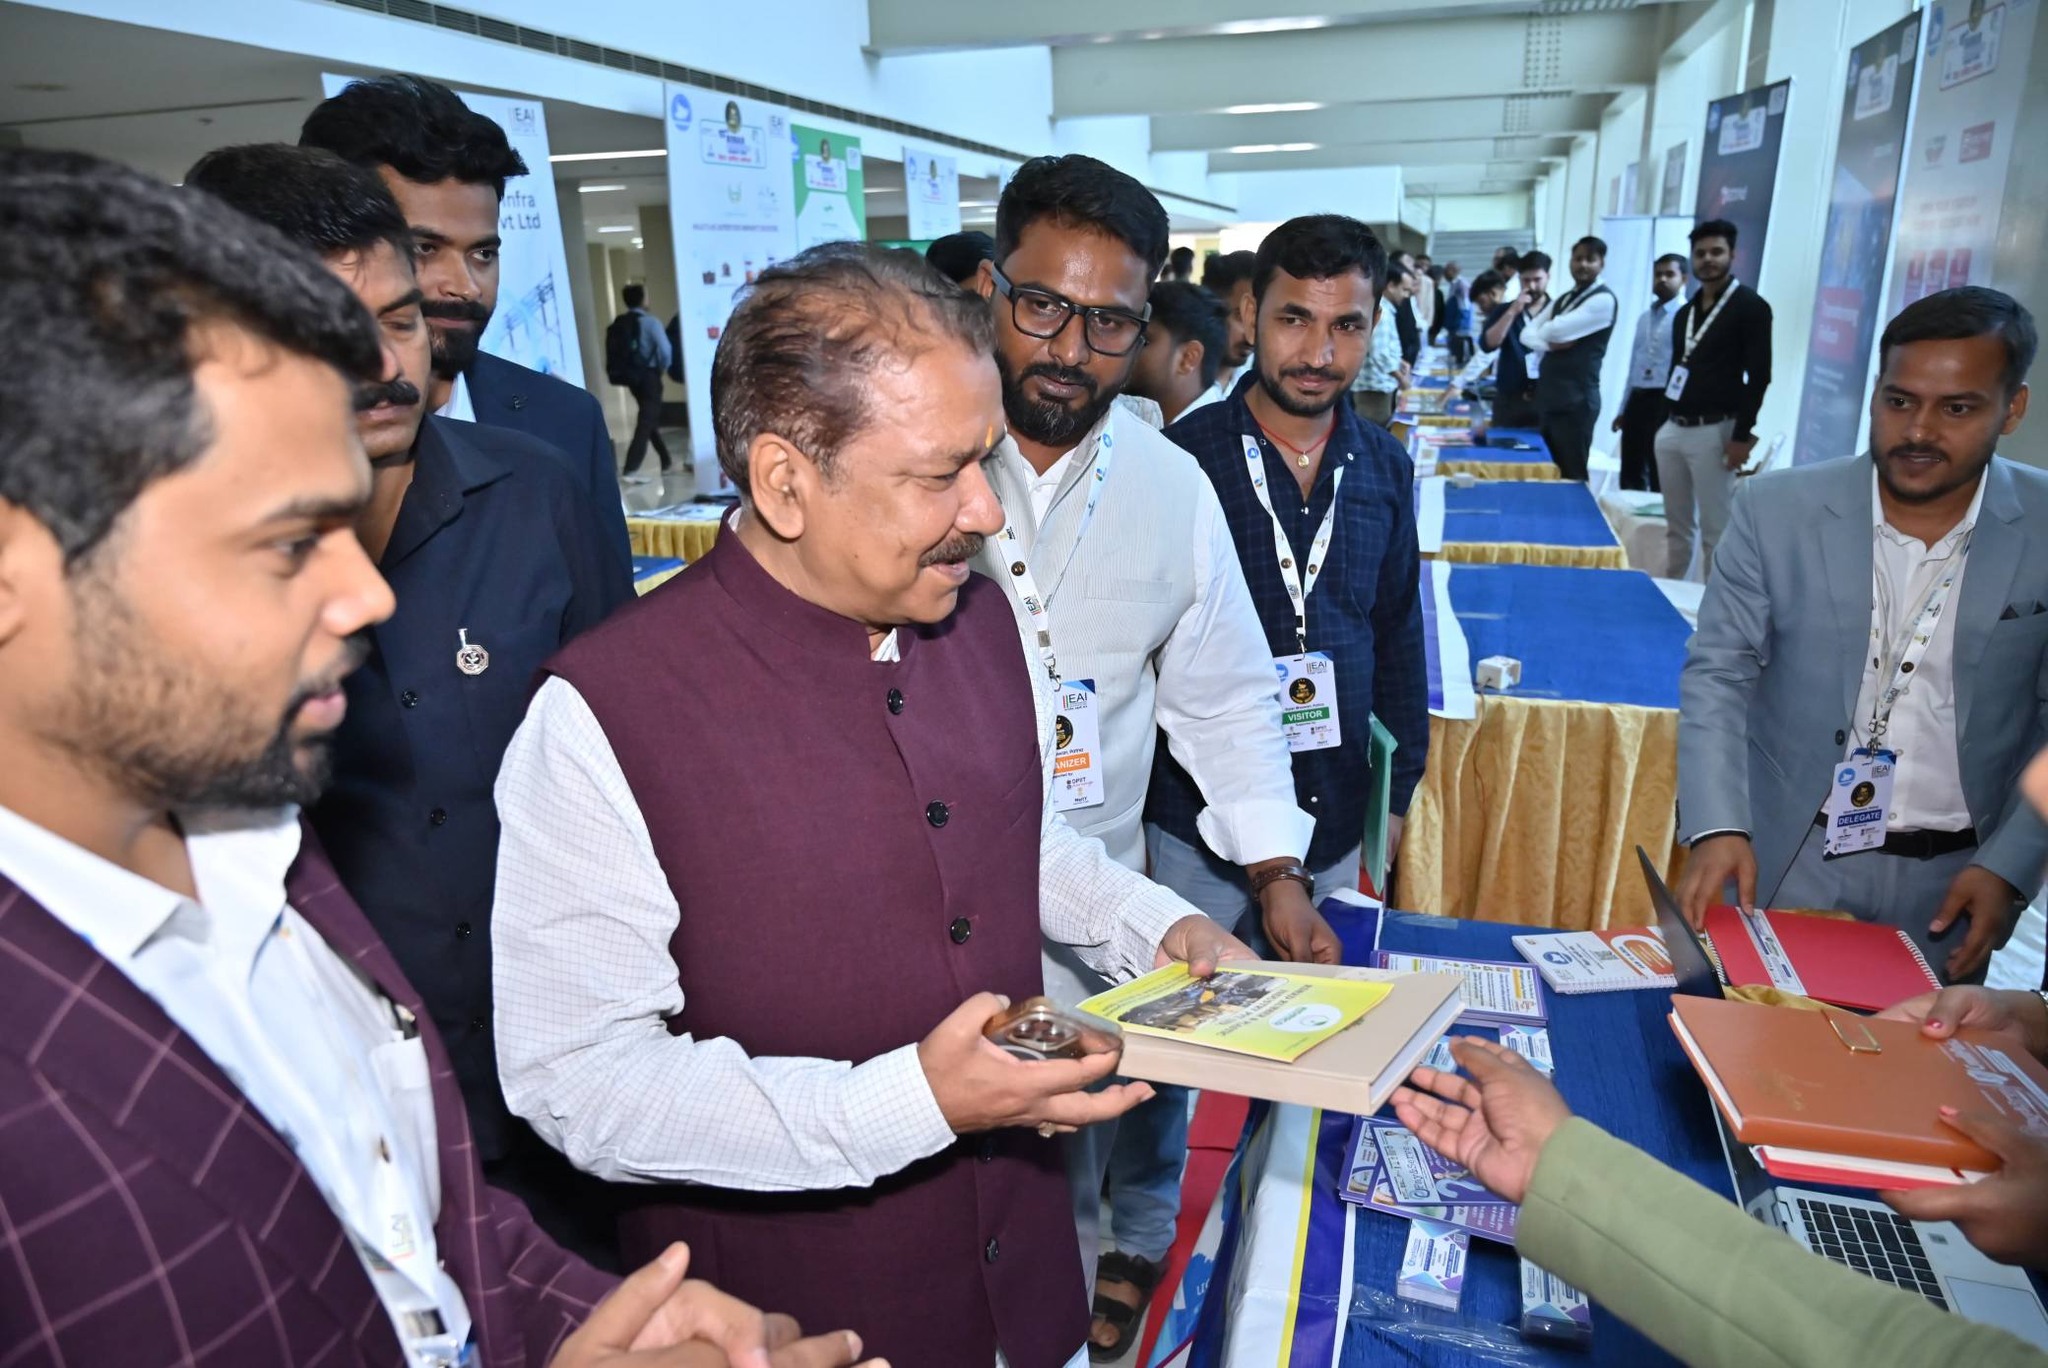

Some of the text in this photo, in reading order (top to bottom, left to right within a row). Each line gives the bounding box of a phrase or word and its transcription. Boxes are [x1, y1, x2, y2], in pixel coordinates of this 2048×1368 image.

[500, 213, 541, 230] vt Ltd
[1287, 709, 1323, 722] VISITOR
[1055, 757, 1087, 769] ANIZER
[1838, 811, 1880, 825] DELEGATE
